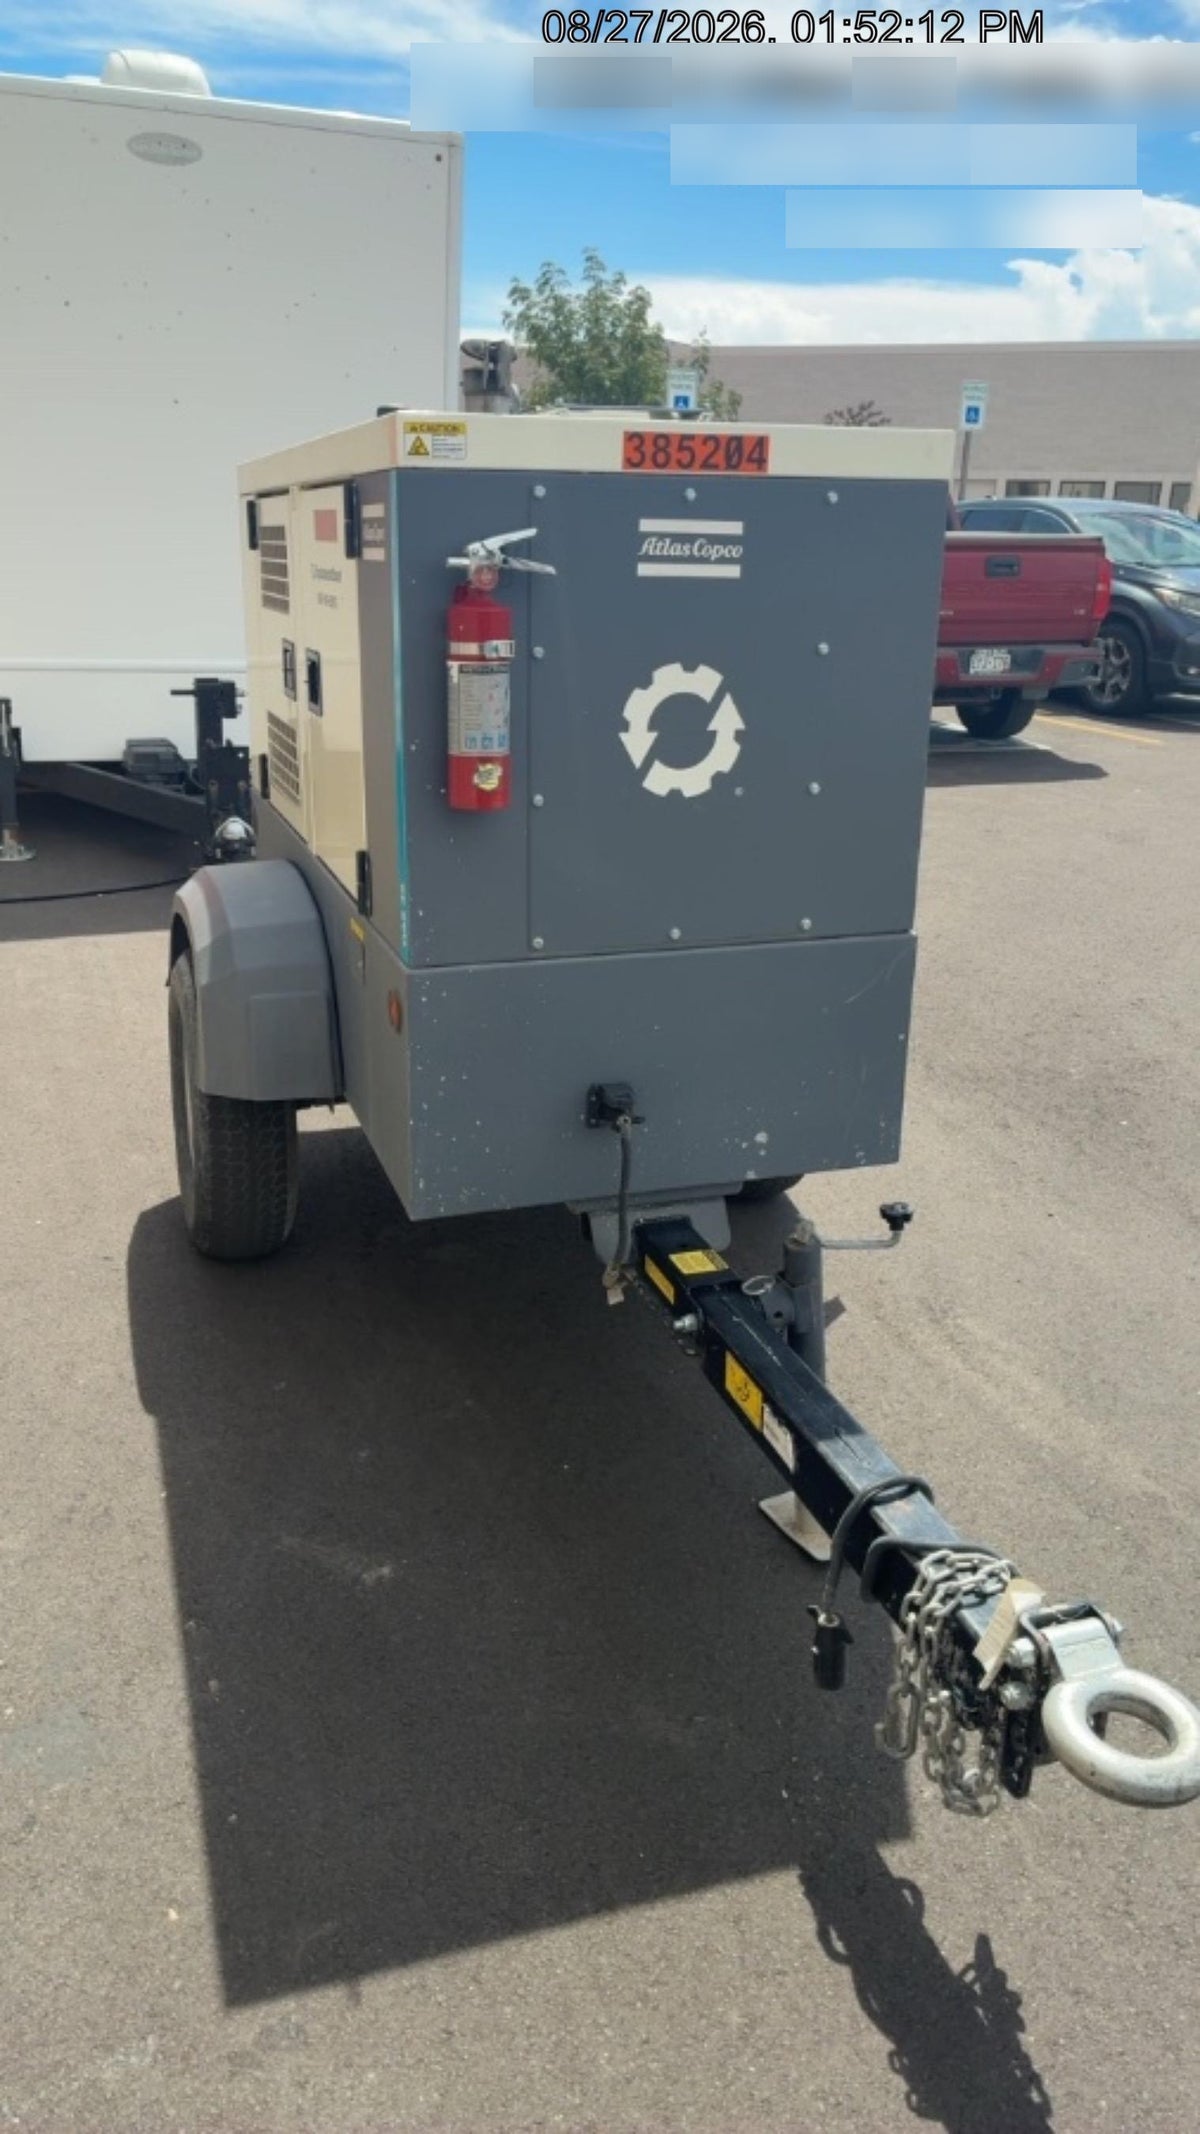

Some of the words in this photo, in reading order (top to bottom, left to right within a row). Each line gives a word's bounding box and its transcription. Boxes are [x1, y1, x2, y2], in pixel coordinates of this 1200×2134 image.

[626, 432, 767, 470] 385204
[637, 536, 691, 556] Atlas
[692, 538, 743, 561] Copco
